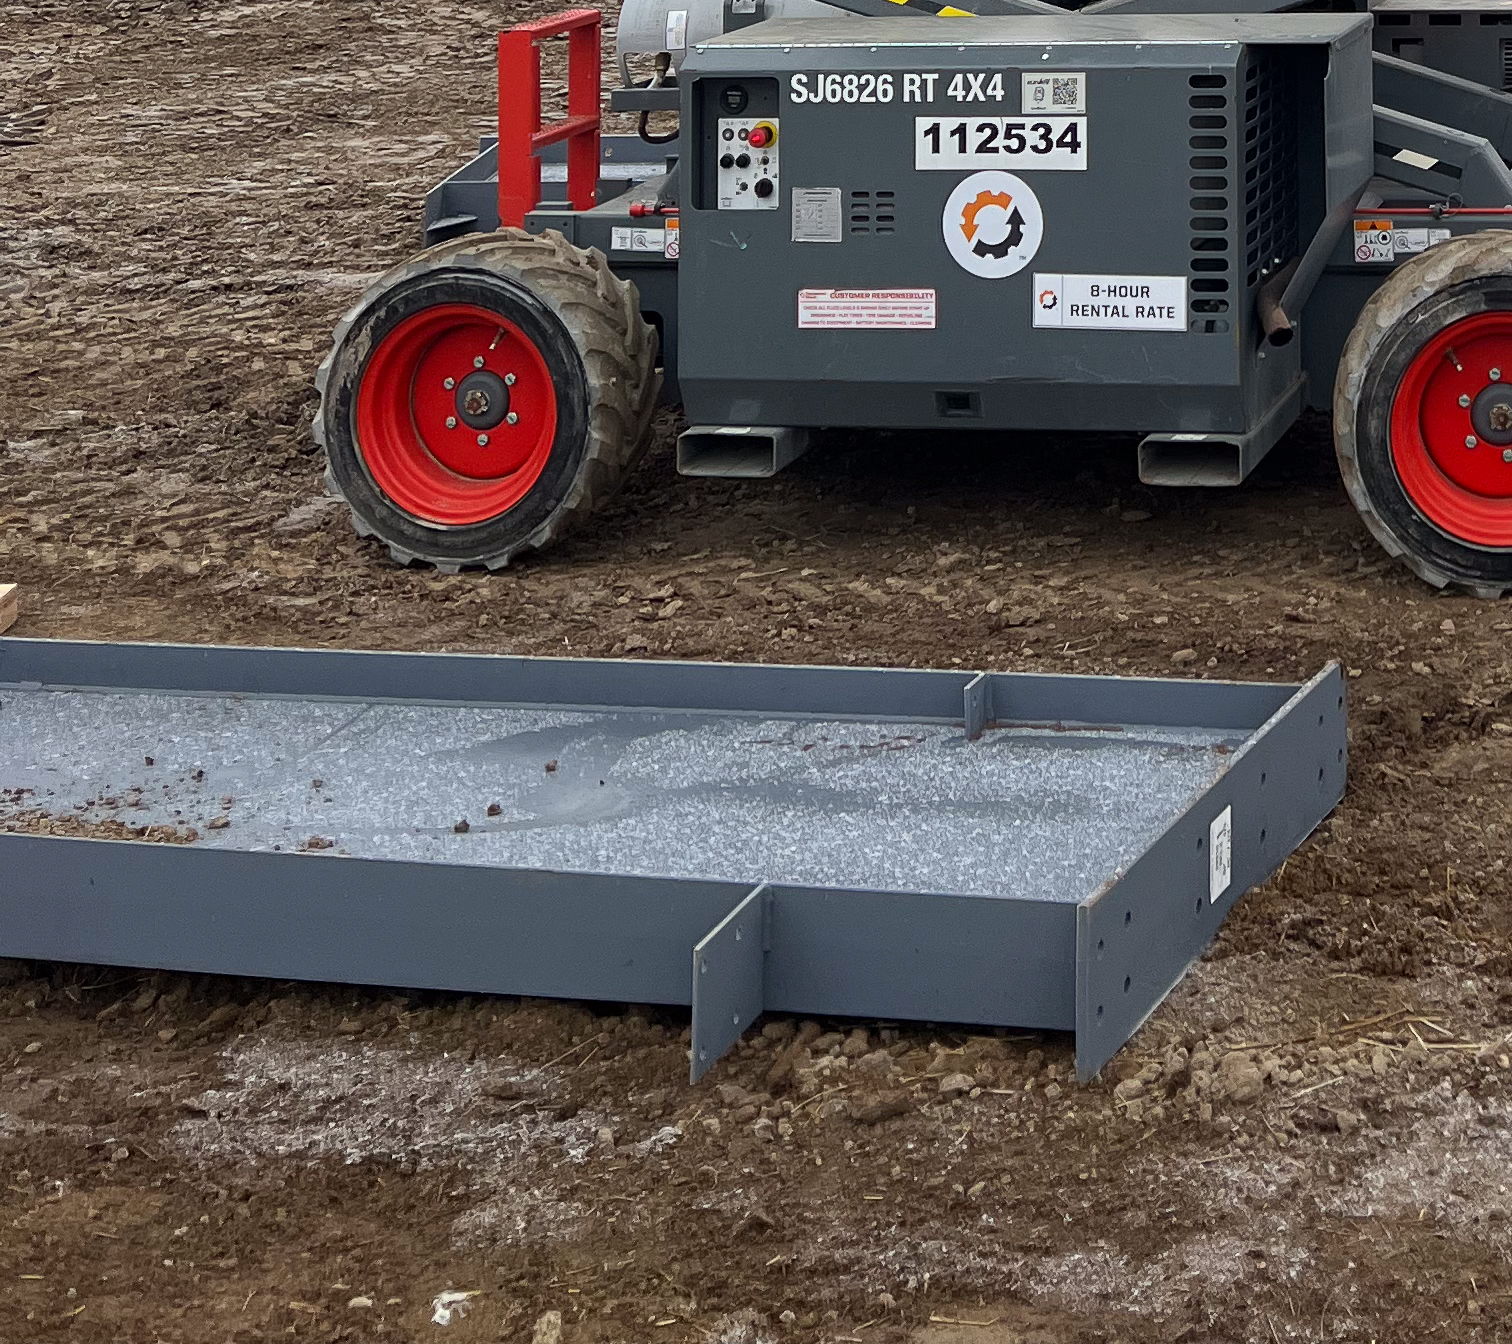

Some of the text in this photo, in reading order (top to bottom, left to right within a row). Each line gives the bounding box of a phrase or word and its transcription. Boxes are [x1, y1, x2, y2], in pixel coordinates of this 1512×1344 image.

[790, 73, 1005, 104] SJ6826 RT 4X4
[923, 123, 1082, 155] 112534
[1090, 284, 1150, 299] 8-HOUR
[1070, 304, 1175, 319] RENTAL RATE
